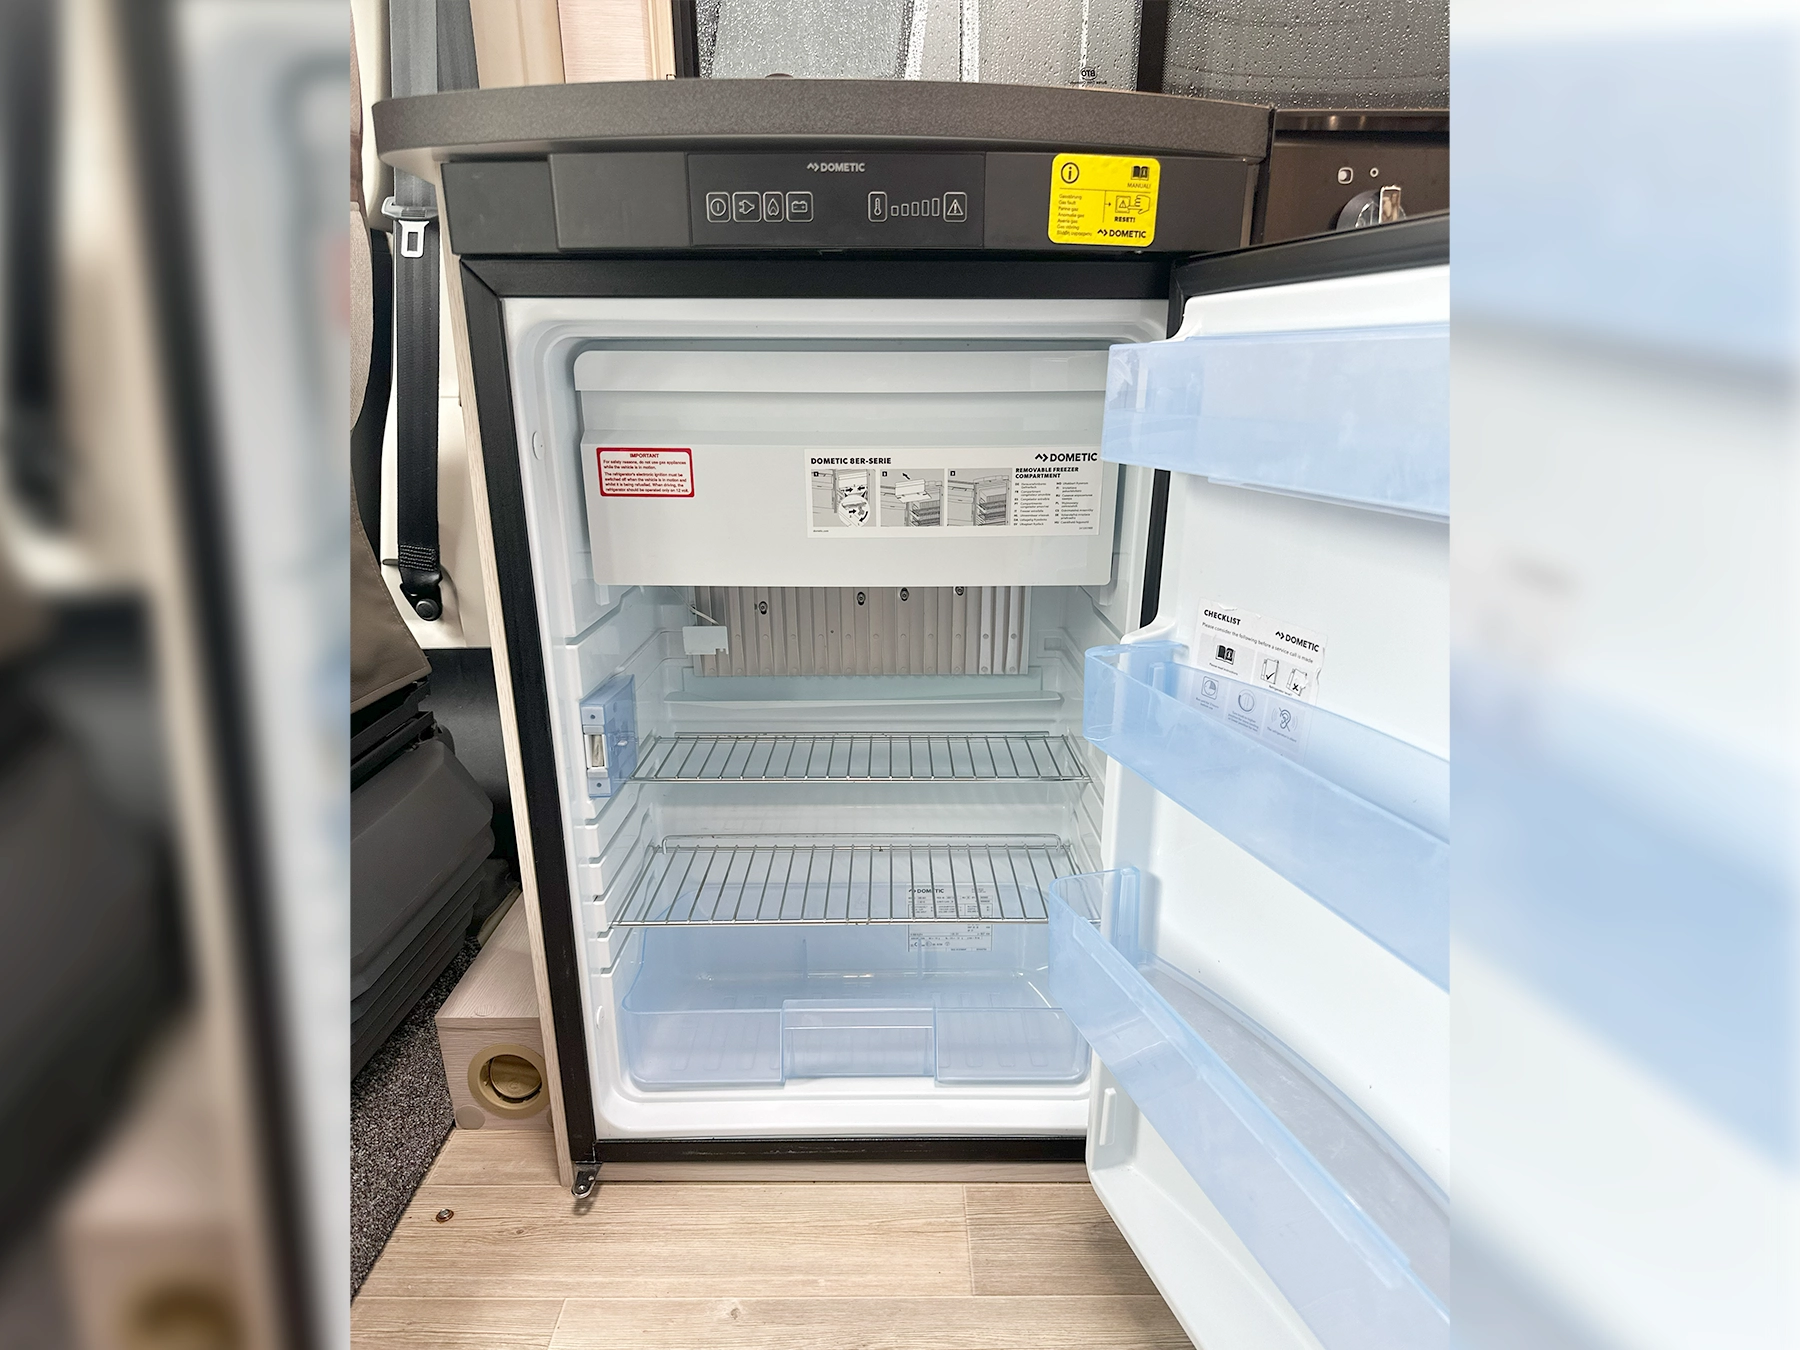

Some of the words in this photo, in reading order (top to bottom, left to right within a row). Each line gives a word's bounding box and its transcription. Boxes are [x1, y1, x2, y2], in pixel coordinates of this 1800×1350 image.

[820, 163, 865, 172] DOMETIC
[1109, 230, 1146, 238] DOMETIC
[1050, 453, 1098, 462] DOMETIC
[1204, 609, 1241, 625] CHECKLIST
[1285, 634, 1320, 652] DOMETIC
